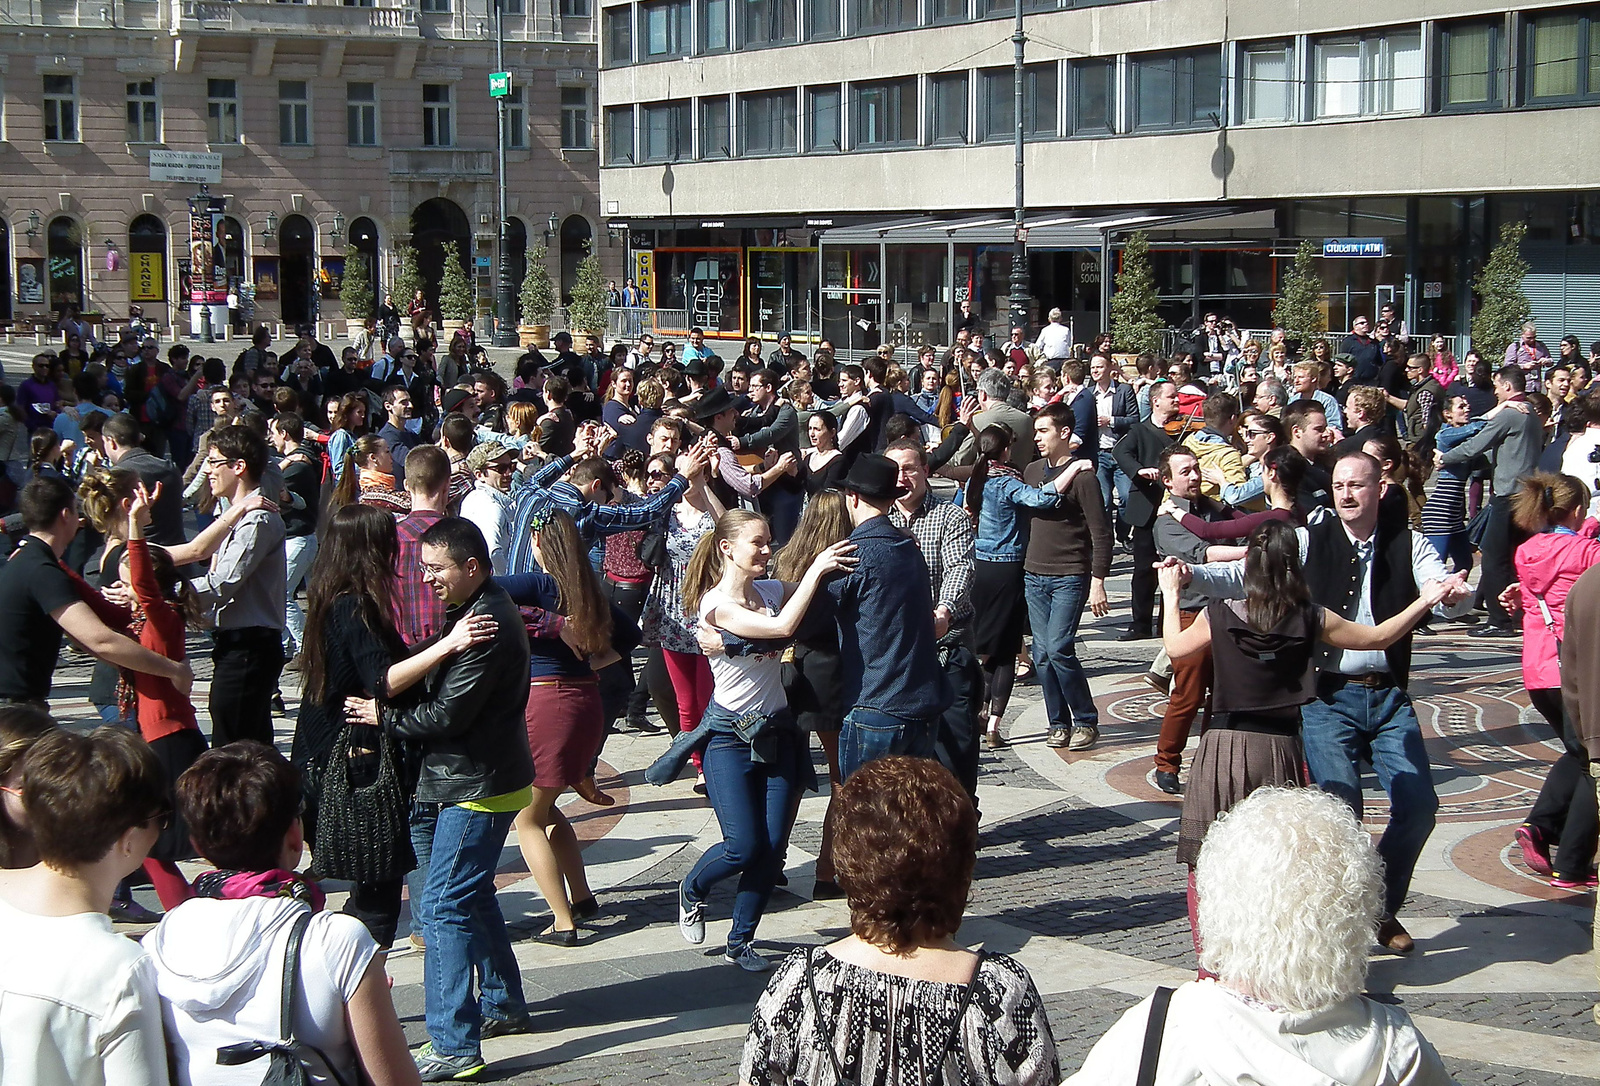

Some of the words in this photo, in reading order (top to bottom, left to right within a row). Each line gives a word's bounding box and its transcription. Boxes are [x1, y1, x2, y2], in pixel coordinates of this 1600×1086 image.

[1364, 243, 1380, 253] ATM
[1080, 262, 1099, 272] OPEN
[140, 254, 152, 294] CHANGE
[1080, 273, 1100, 284] SOON
